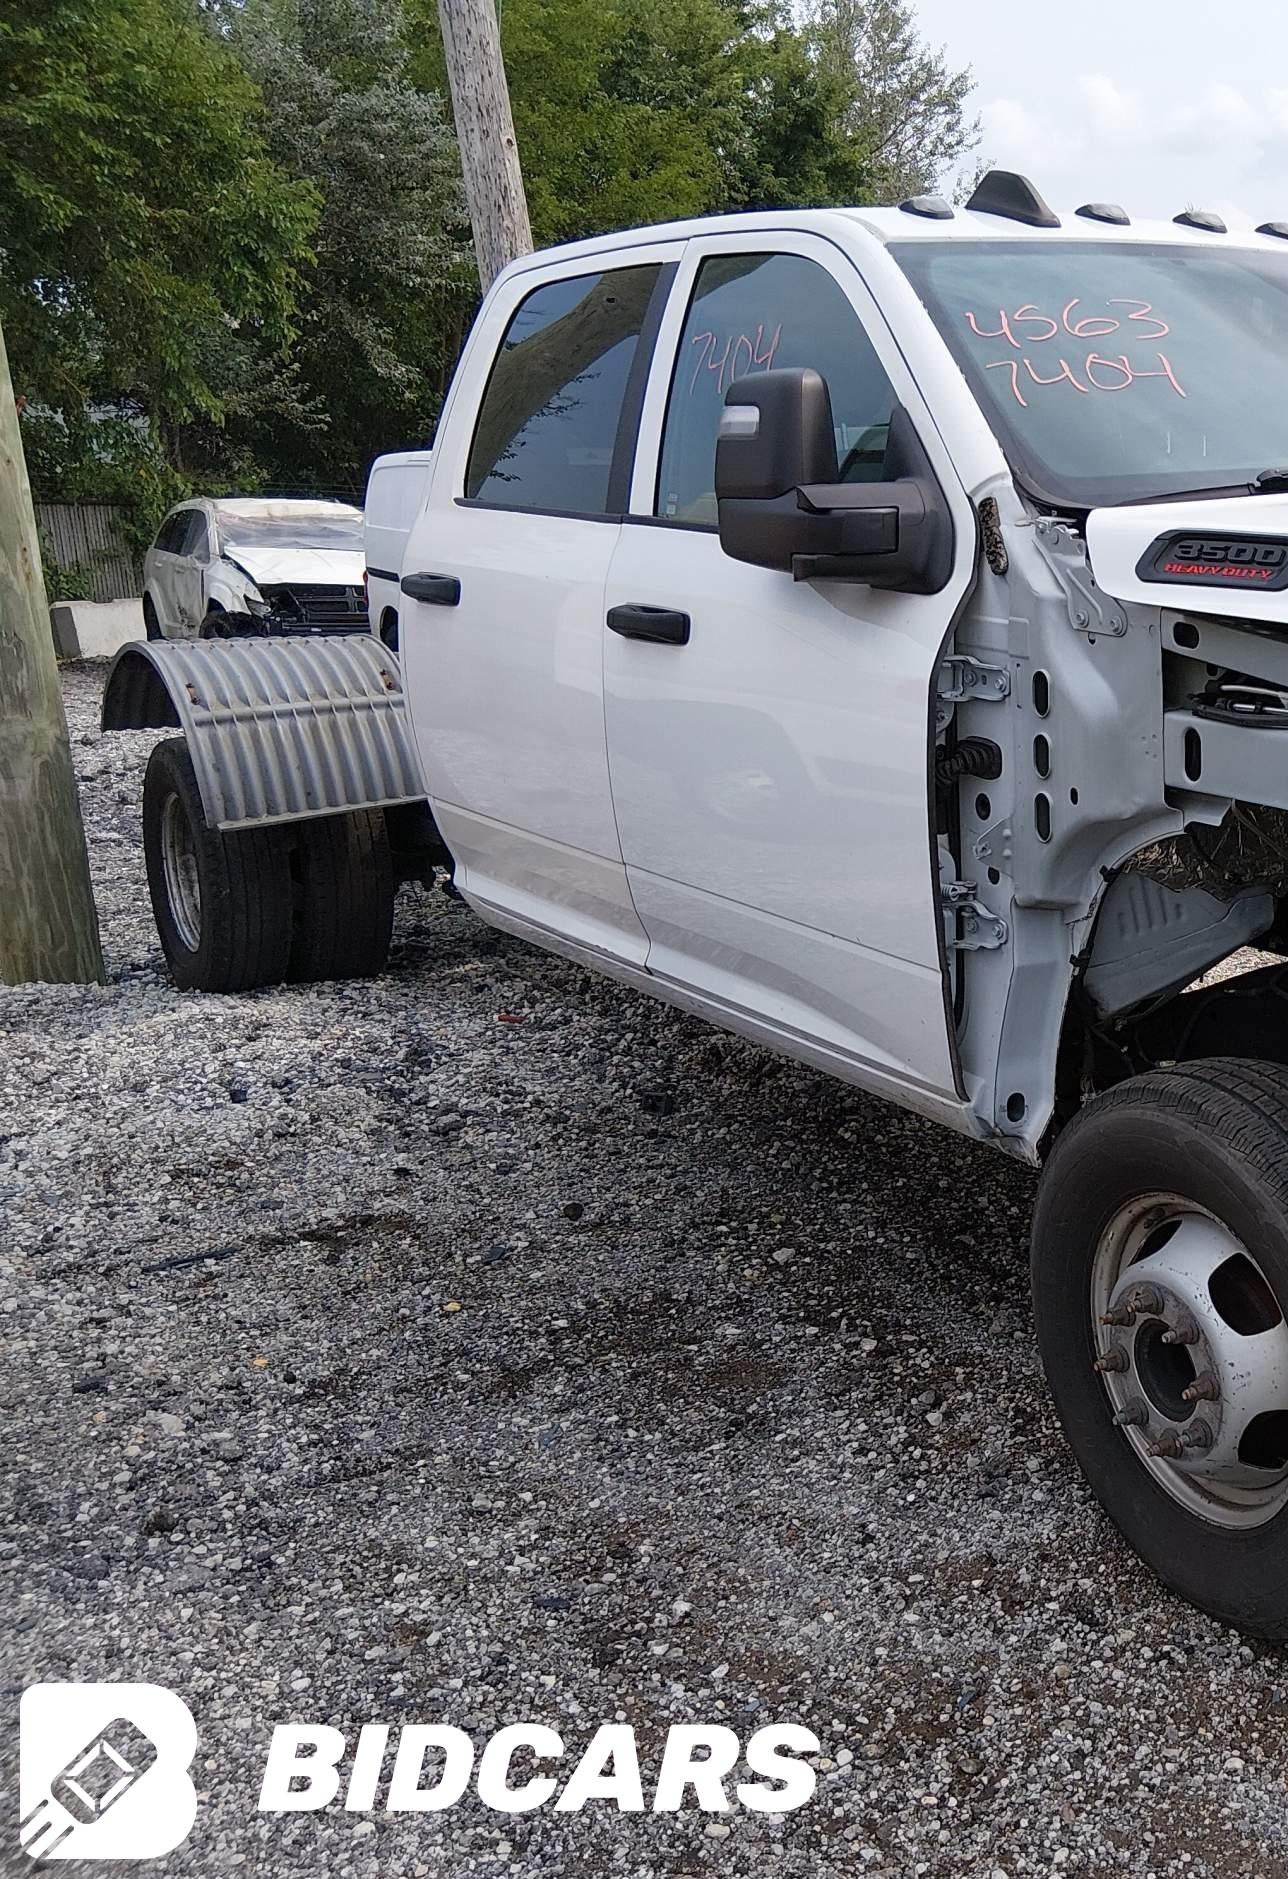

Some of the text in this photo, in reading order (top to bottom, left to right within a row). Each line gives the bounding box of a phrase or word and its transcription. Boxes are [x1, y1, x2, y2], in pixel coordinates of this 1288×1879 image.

[965, 298, 1169, 348] 4563
[690, 323, 783, 395] 7404
[985, 352, 1187, 407] 7404
[1163, 563, 1273, 581] HEAVY DUTY
[1174, 542, 1284, 567] 3500
